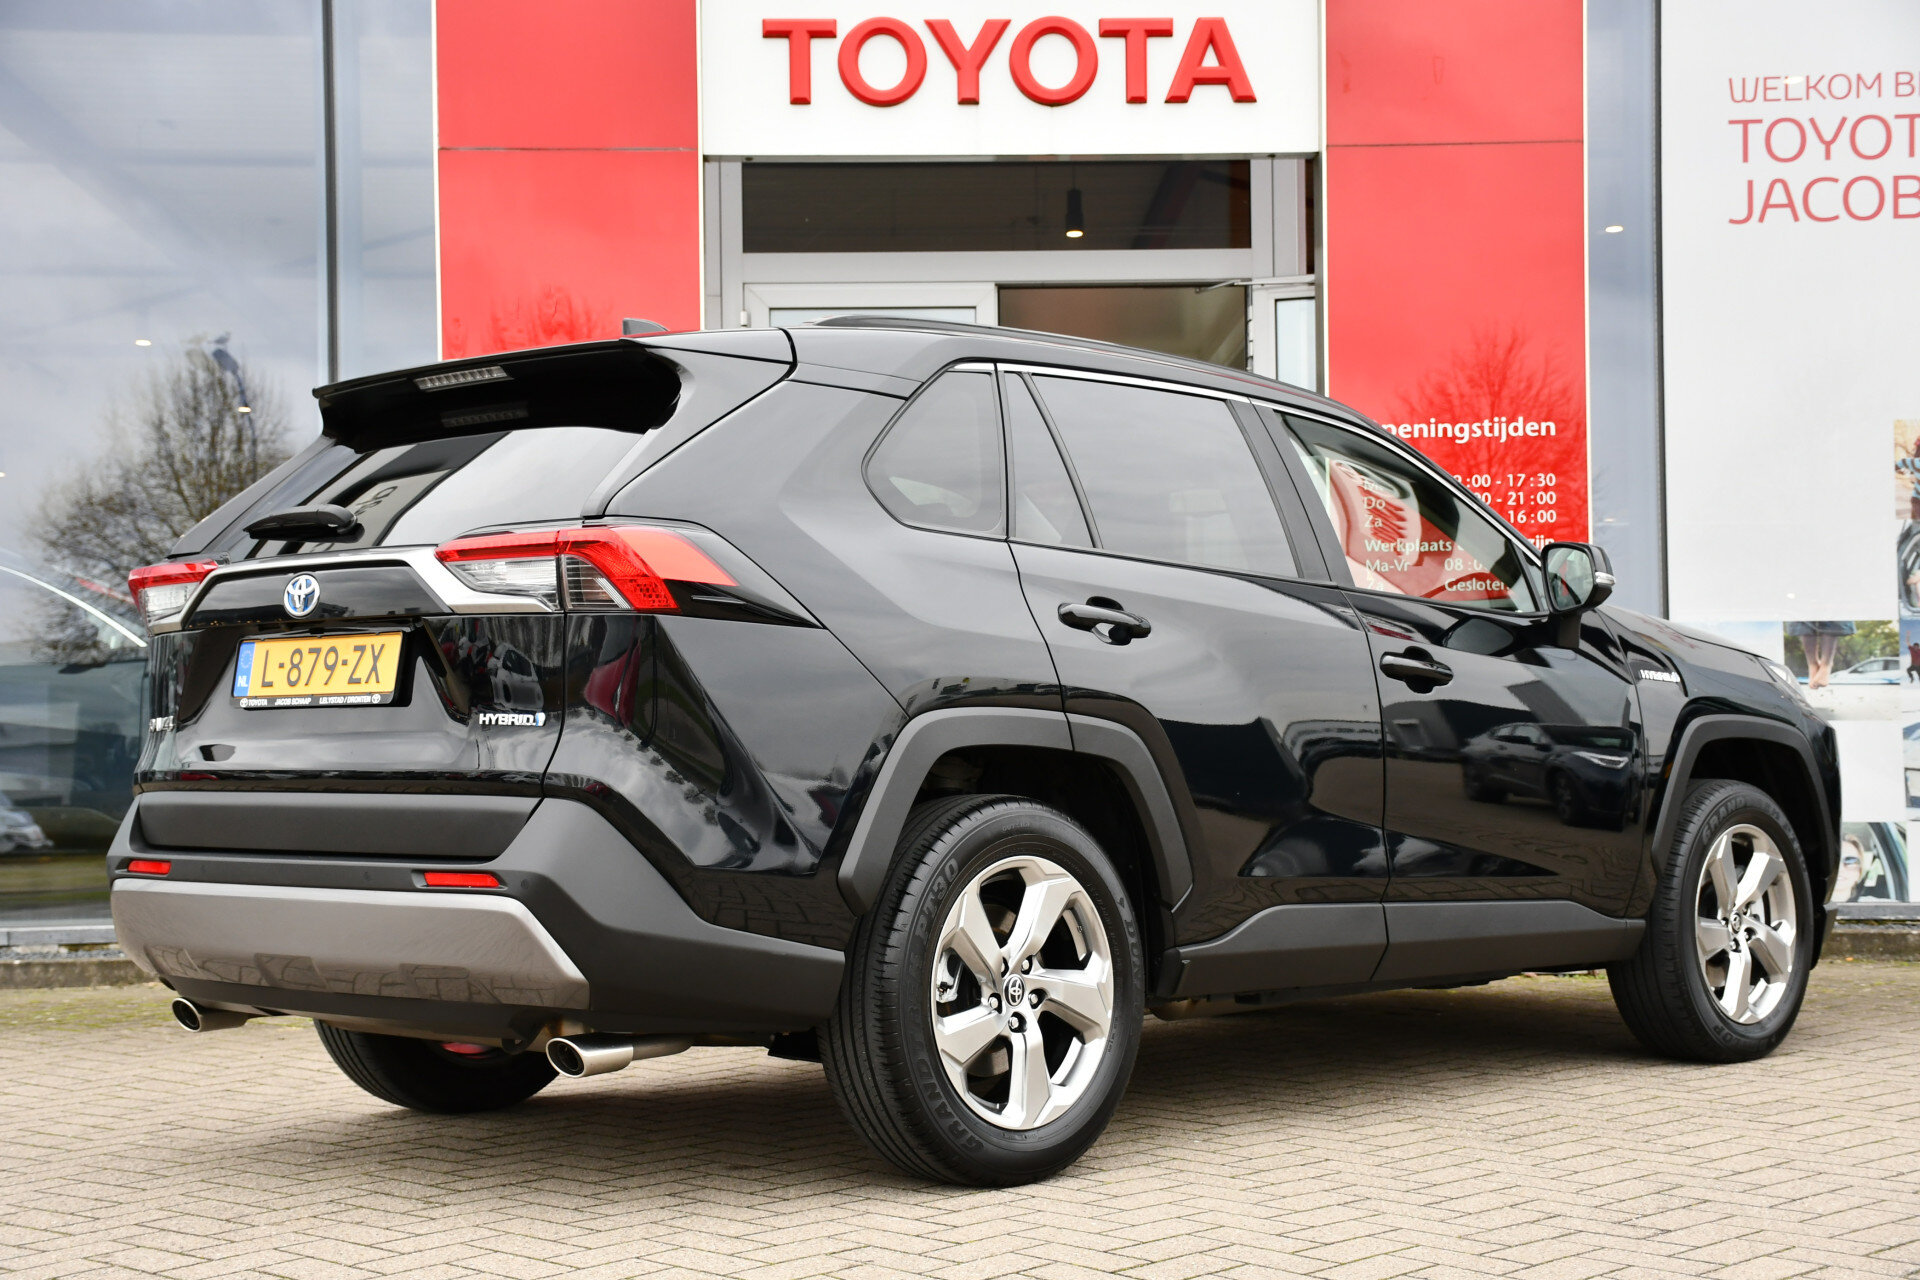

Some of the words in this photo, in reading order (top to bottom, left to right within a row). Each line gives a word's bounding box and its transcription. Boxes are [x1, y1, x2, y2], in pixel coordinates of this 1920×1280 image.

[762, 16, 1257, 106] TOYOTA
[1728, 72, 1882, 103] WELKOM
[1895, 71, 1920, 97] B
[1728, 175, 1920, 225] JACOB
[1365, 538, 1452, 555] Werkplaats
[237, 675, 249, 687] NL
[261, 643, 385, 688] L-879-ZX
[479, 713, 535, 726] HYBRID
